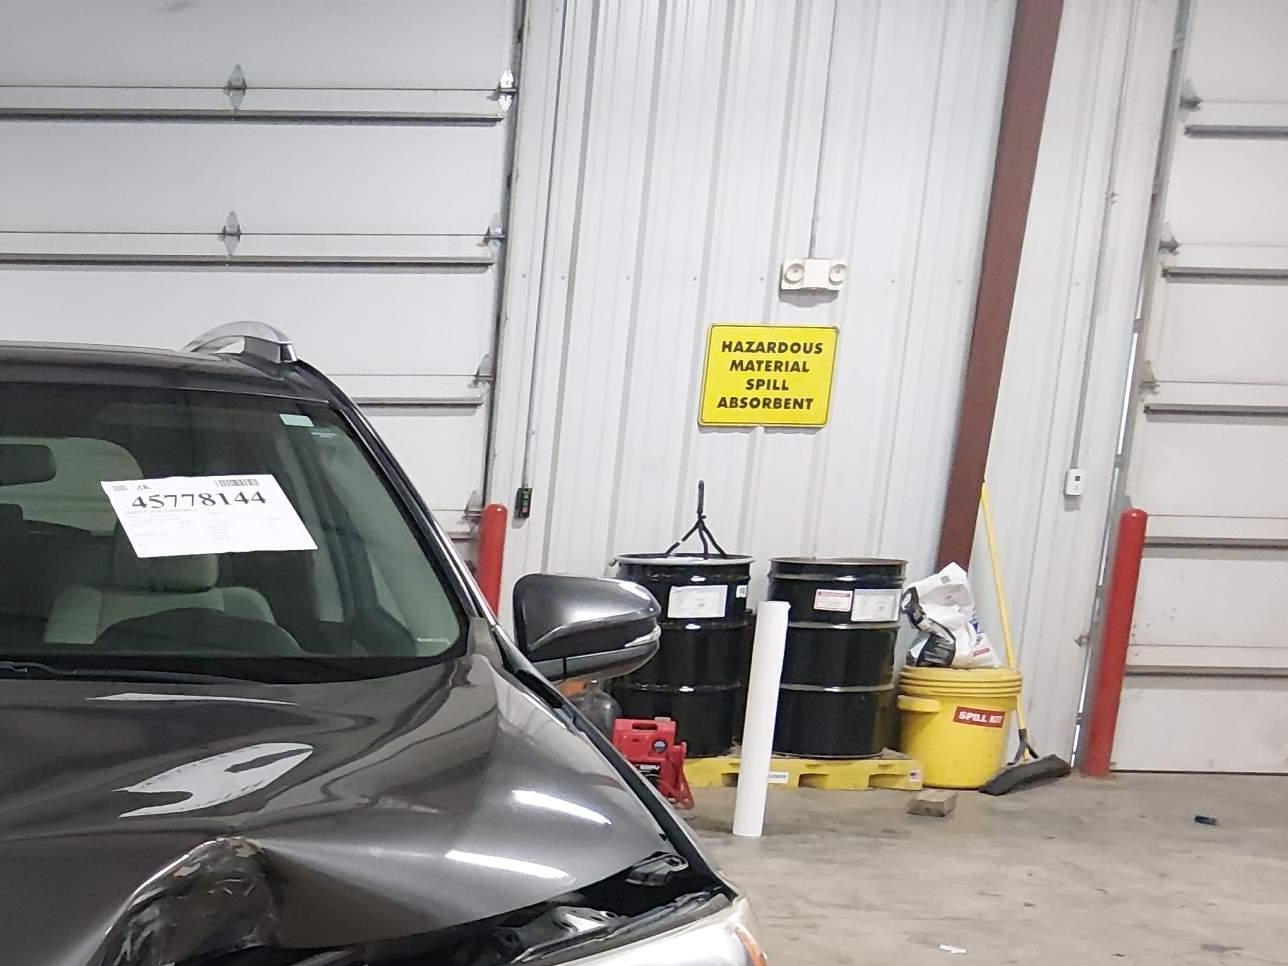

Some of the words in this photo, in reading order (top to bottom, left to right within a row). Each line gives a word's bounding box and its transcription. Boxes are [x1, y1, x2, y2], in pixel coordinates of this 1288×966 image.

[721, 341, 823, 354] HAZARDOUS
[729, 359, 810, 373] MATERIAL
[745, 378, 789, 391] SPILL
[717, 397, 813, 410] ABSORBENT
[131, 491, 267, 509] 45778144
[958, 711, 988, 723] SPILL
